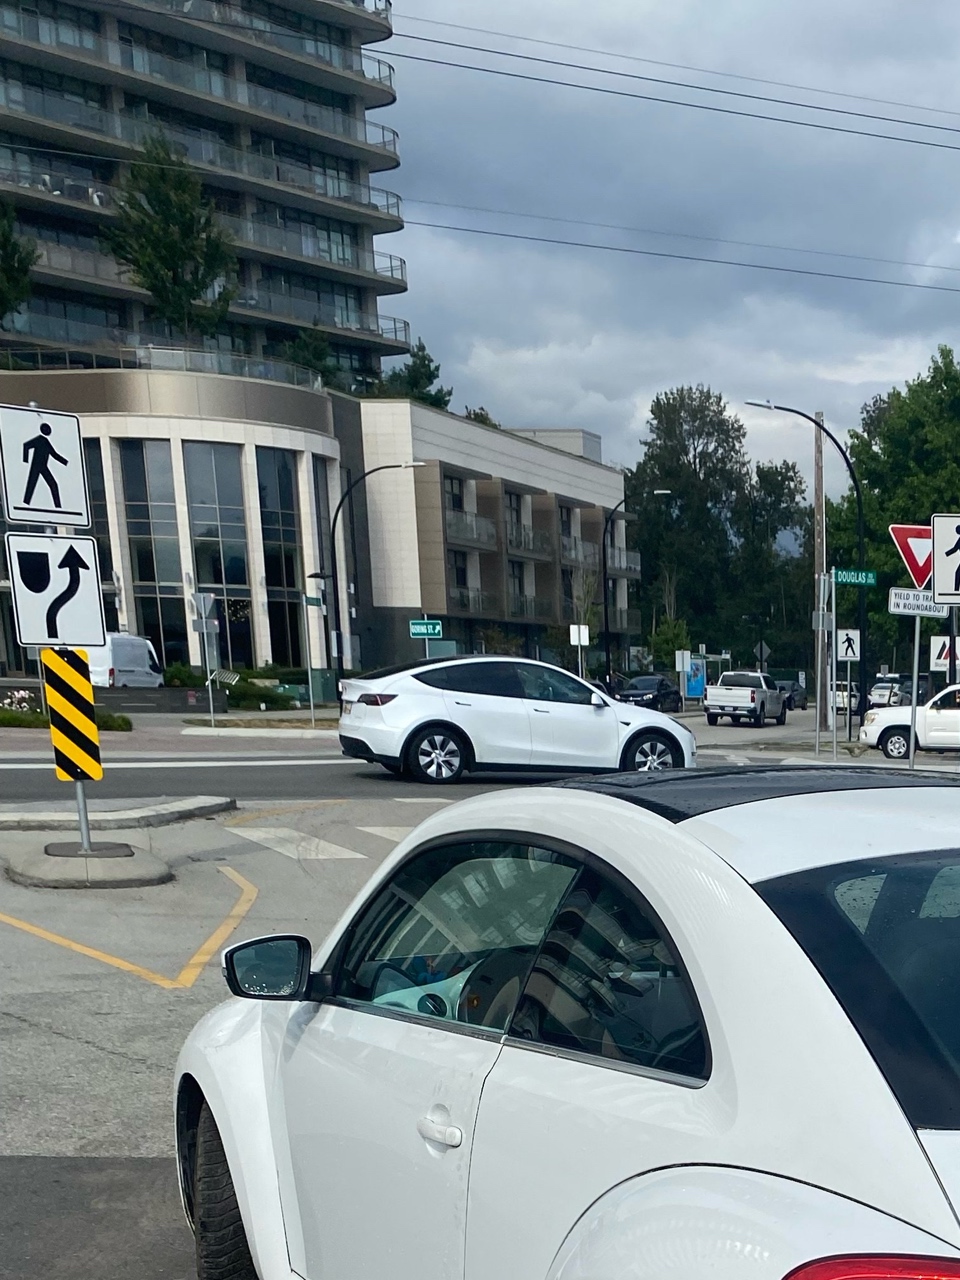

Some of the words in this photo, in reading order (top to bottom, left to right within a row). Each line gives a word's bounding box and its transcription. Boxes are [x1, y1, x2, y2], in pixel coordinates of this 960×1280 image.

[838, 571, 866, 583] DOUGLAS
[893, 591, 911, 601] YIELD
[912, 593, 921, 602] TO
[893, 602, 901, 610] IN
[903, 603, 945, 613] ROUNDABOUT
